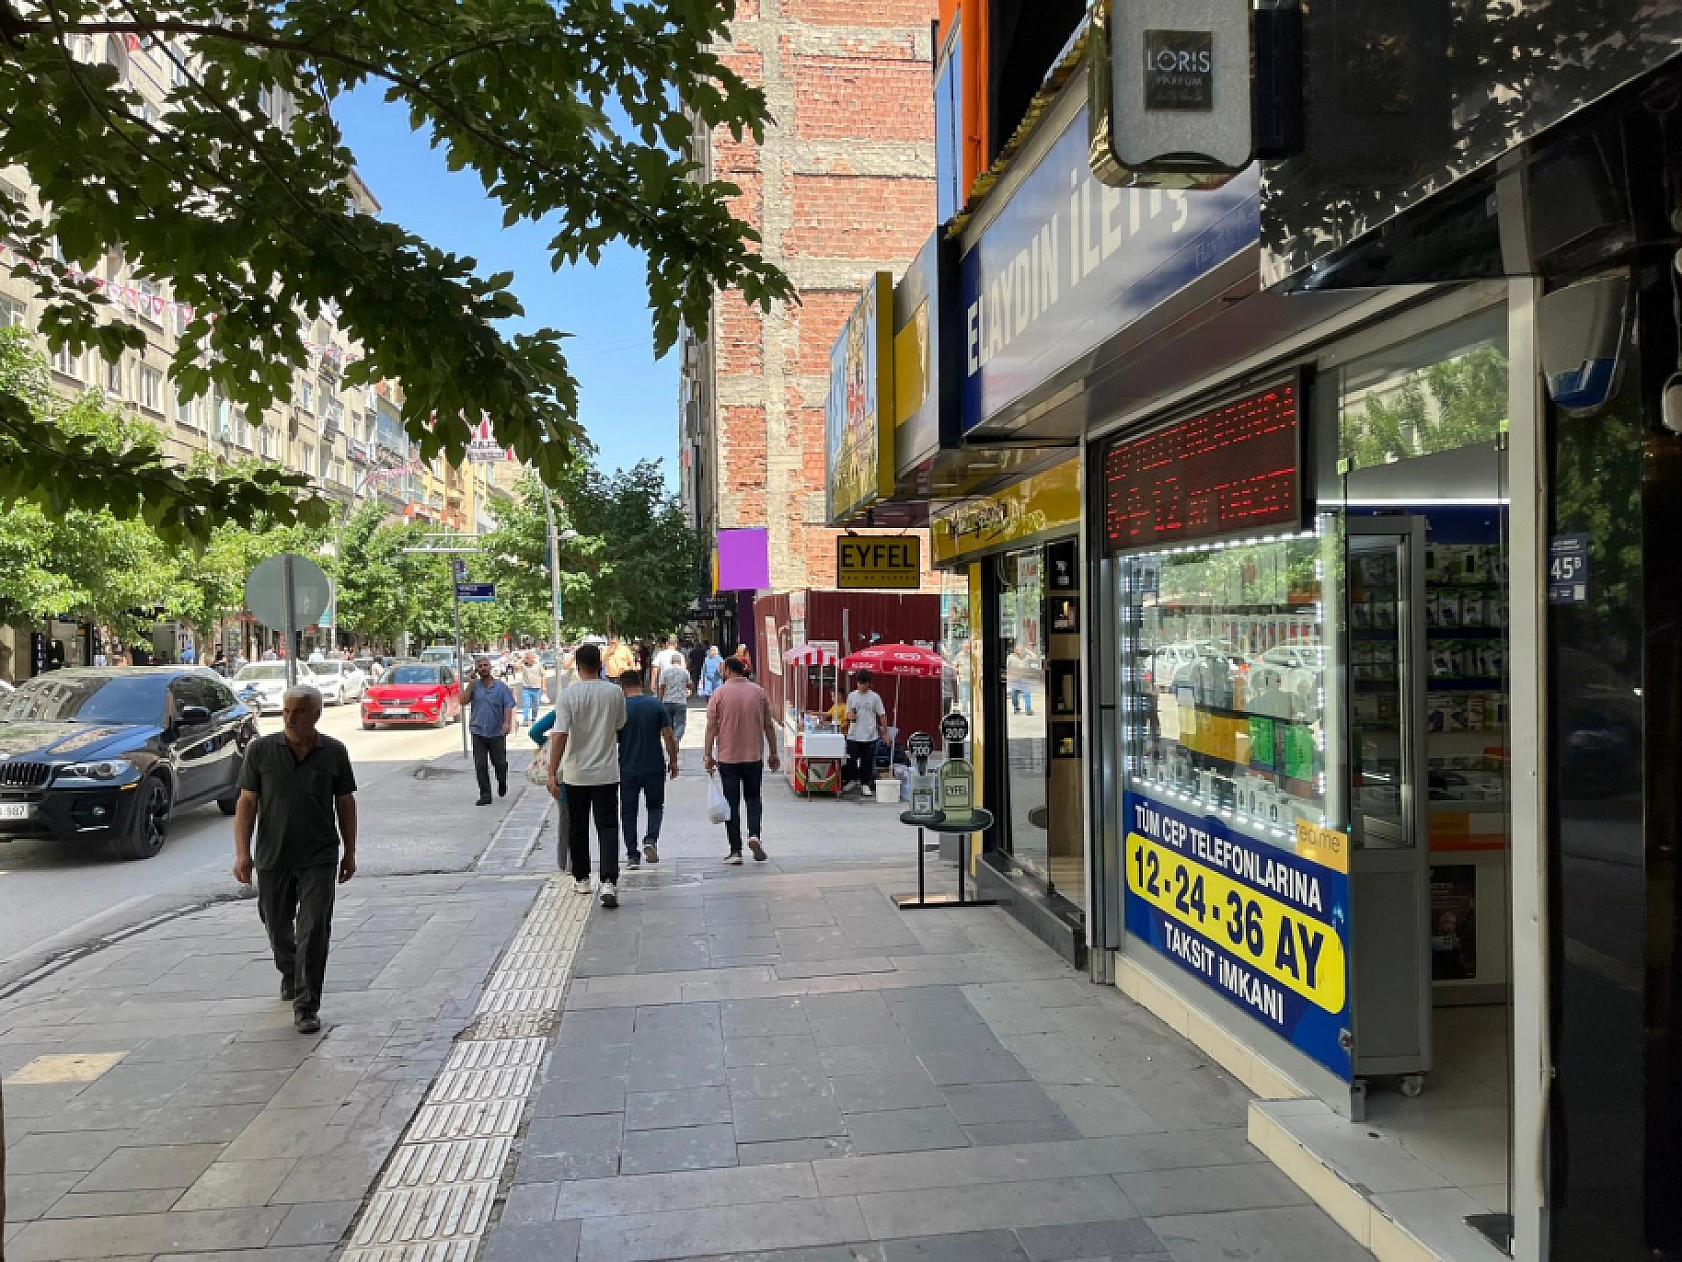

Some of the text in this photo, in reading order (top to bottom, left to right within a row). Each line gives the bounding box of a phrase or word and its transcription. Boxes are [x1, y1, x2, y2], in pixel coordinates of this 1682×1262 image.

[1147, 48, 1210, 73] LORIS
[967, 211, 1059, 378] ELAYDIN
[842, 543, 916, 568] EYFEL
[1135, 801, 1322, 912] TÜM CEP TELEFONLARINA
[1275, 915, 1325, 990] AY
